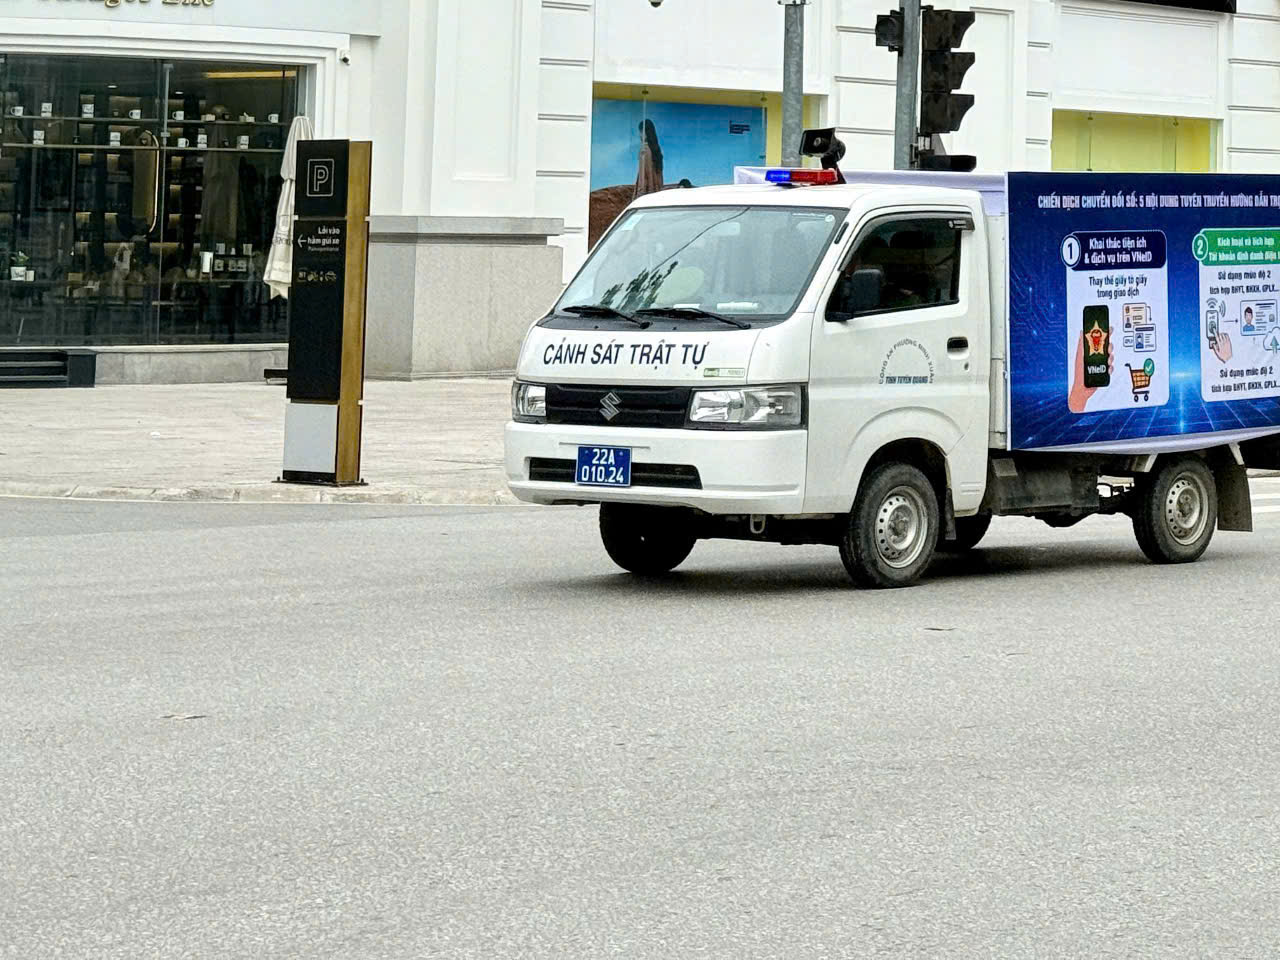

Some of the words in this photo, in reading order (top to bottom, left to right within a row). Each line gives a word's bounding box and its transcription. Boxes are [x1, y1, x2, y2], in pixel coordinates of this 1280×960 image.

[313, 166, 329, 192] P
[1139, 195, 1144, 208] 5
[1089, 237, 1104, 249] Khai
[1136, 236, 1147, 249] ích
[1197, 239, 1204, 255] 2
[1067, 243, 1073, 260] 1
[1084, 252, 1090, 264] &
[1091, 252, 1105, 266] dịch
[1107, 253, 1115, 266] vụ
[1131, 251, 1152, 263] VNeID
[1089, 276, 1103, 287] Thay
[1097, 289, 1112, 299] trong
[1114, 289, 1126, 299] giao
[1127, 288, 1139, 299] dịch
[591, 338, 624, 365] SÁT
[630, 339, 676, 370] TRẬT
[682, 341, 710, 370] TỰ
[1088, 365, 1106, 374] VNeID
[1269, 366, 1274, 375] 2
[592, 448, 616, 465] 22A
[581, 465, 624, 483] 010.24
